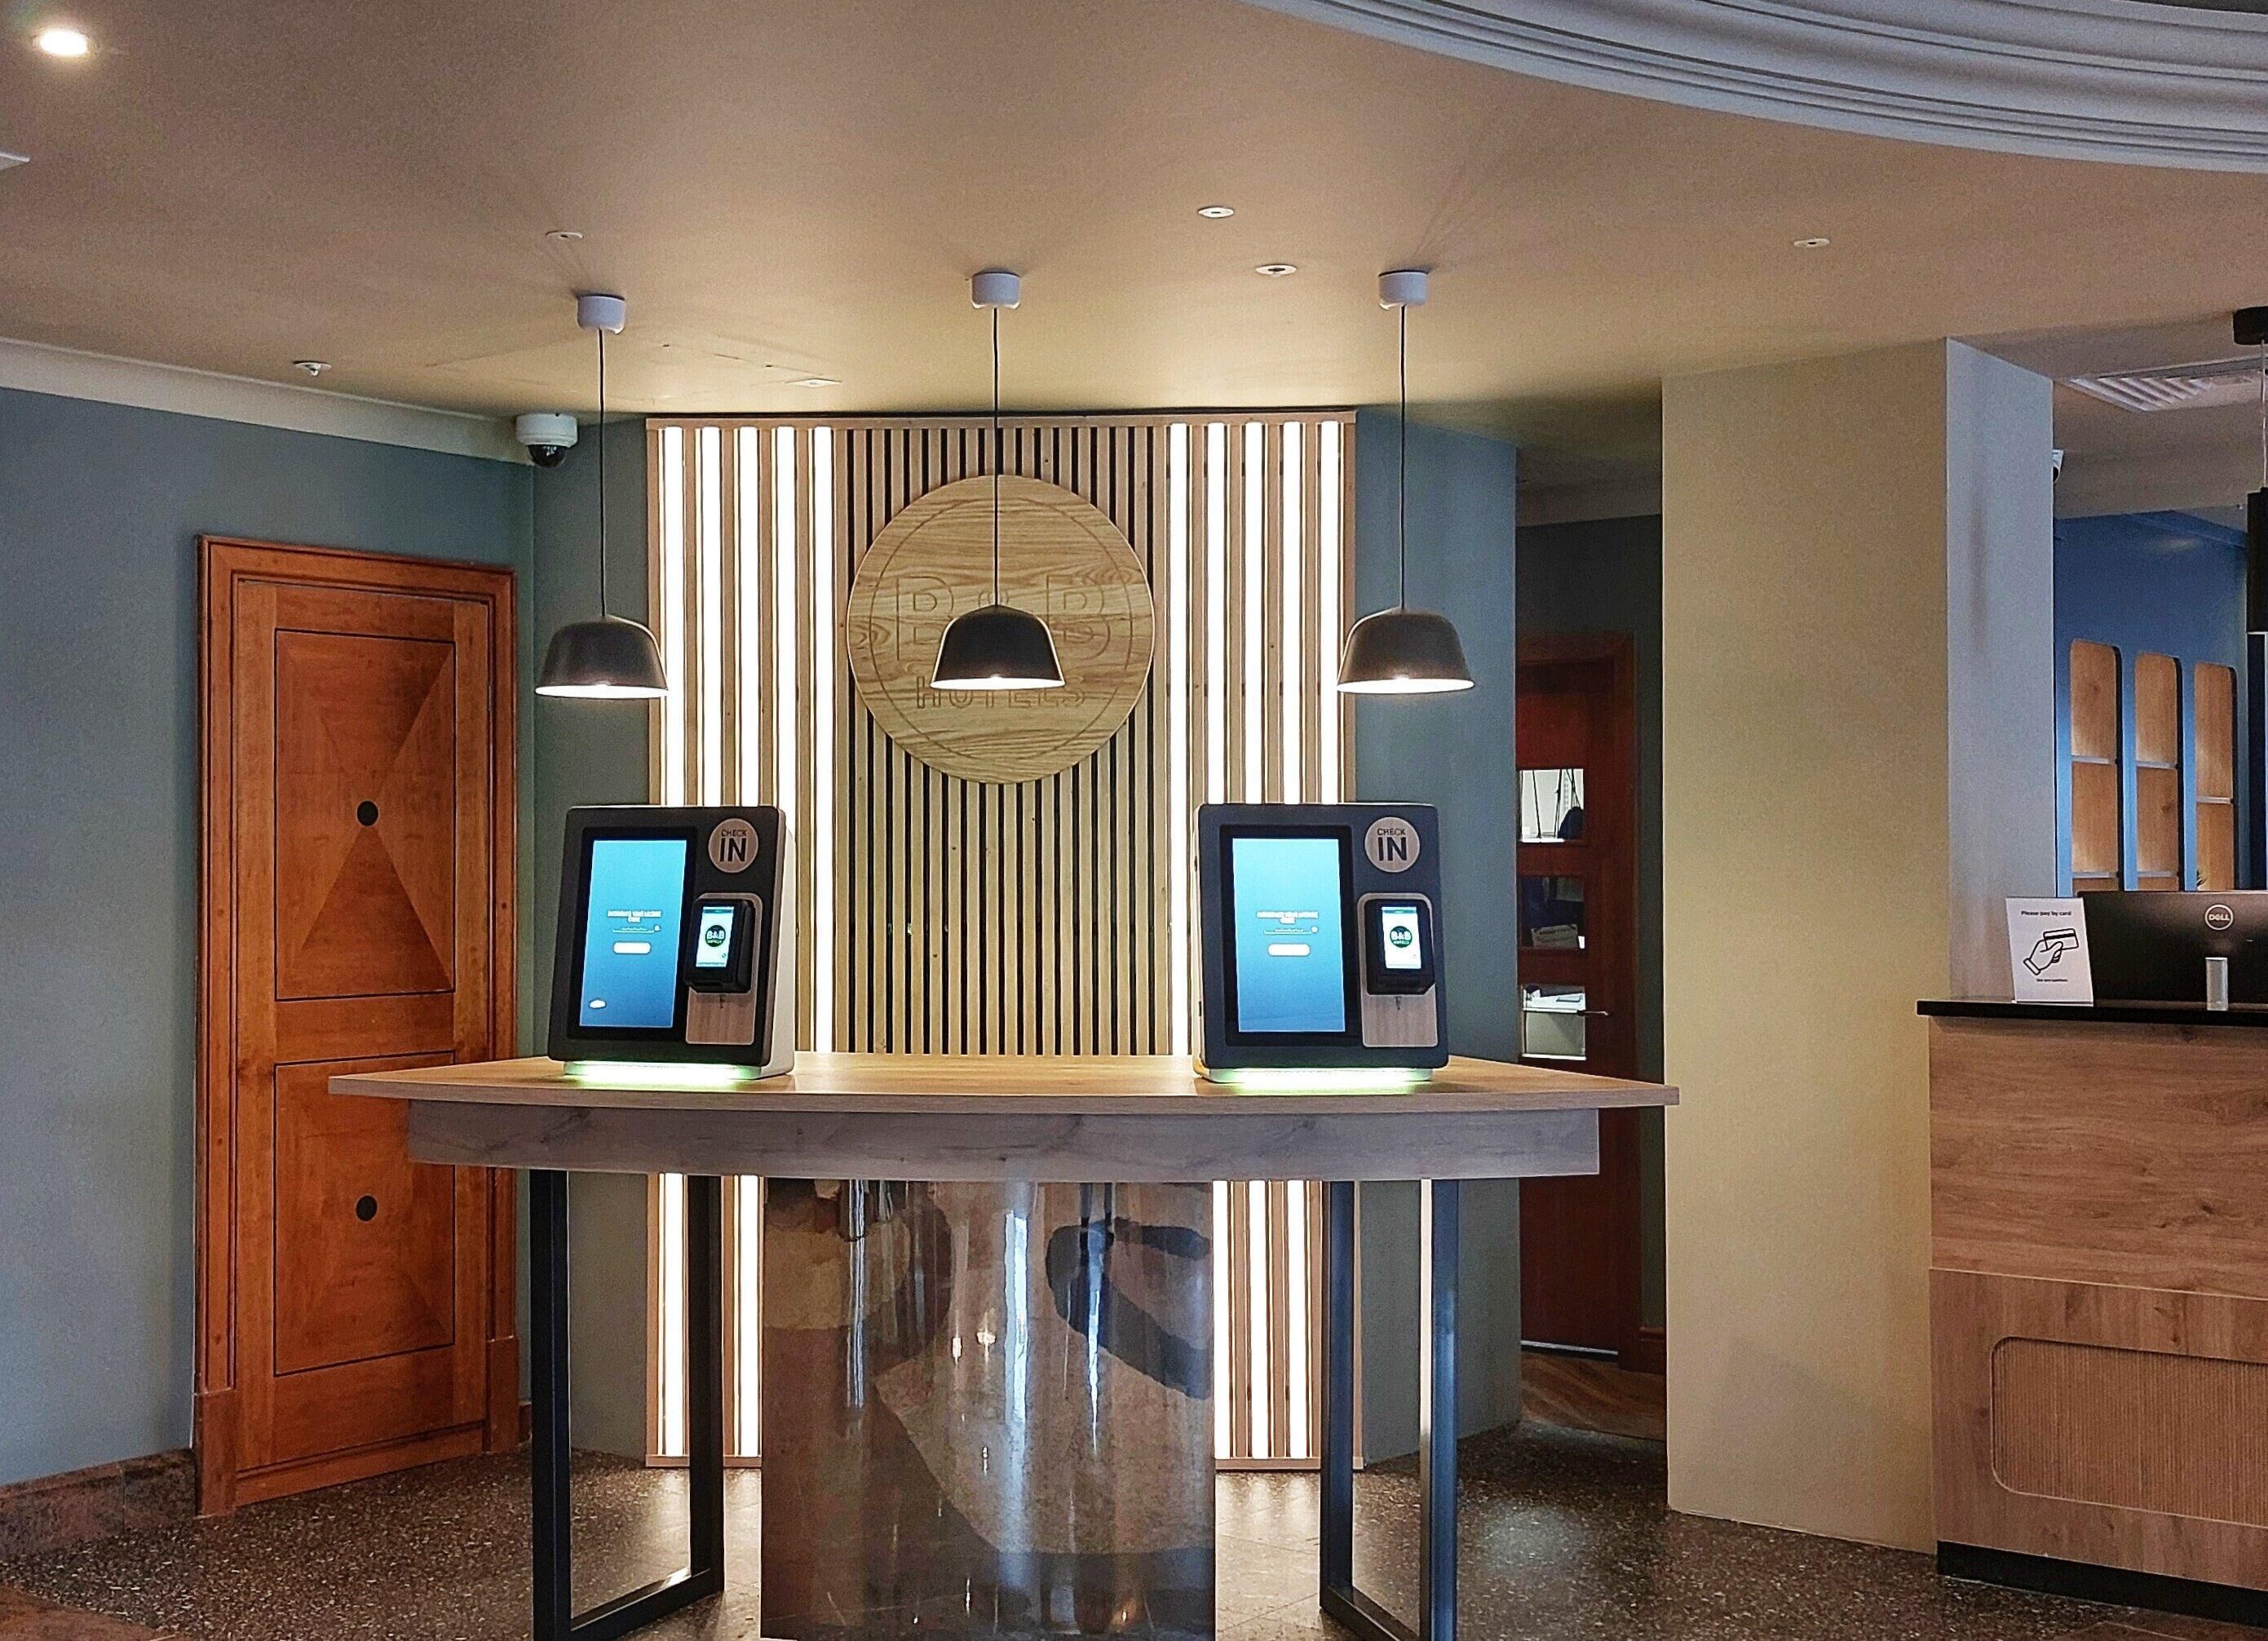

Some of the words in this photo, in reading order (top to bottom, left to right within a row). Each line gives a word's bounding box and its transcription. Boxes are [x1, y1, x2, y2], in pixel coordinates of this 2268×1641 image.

[895, 574, 1112, 661] BB
[721, 829, 748, 837] CHECK
[1377, 828, 1407, 836] CHECK
[719, 838, 747, 862] IN
[1377, 836, 1408, 861] IN
[706, 930, 726, 940] B&B
